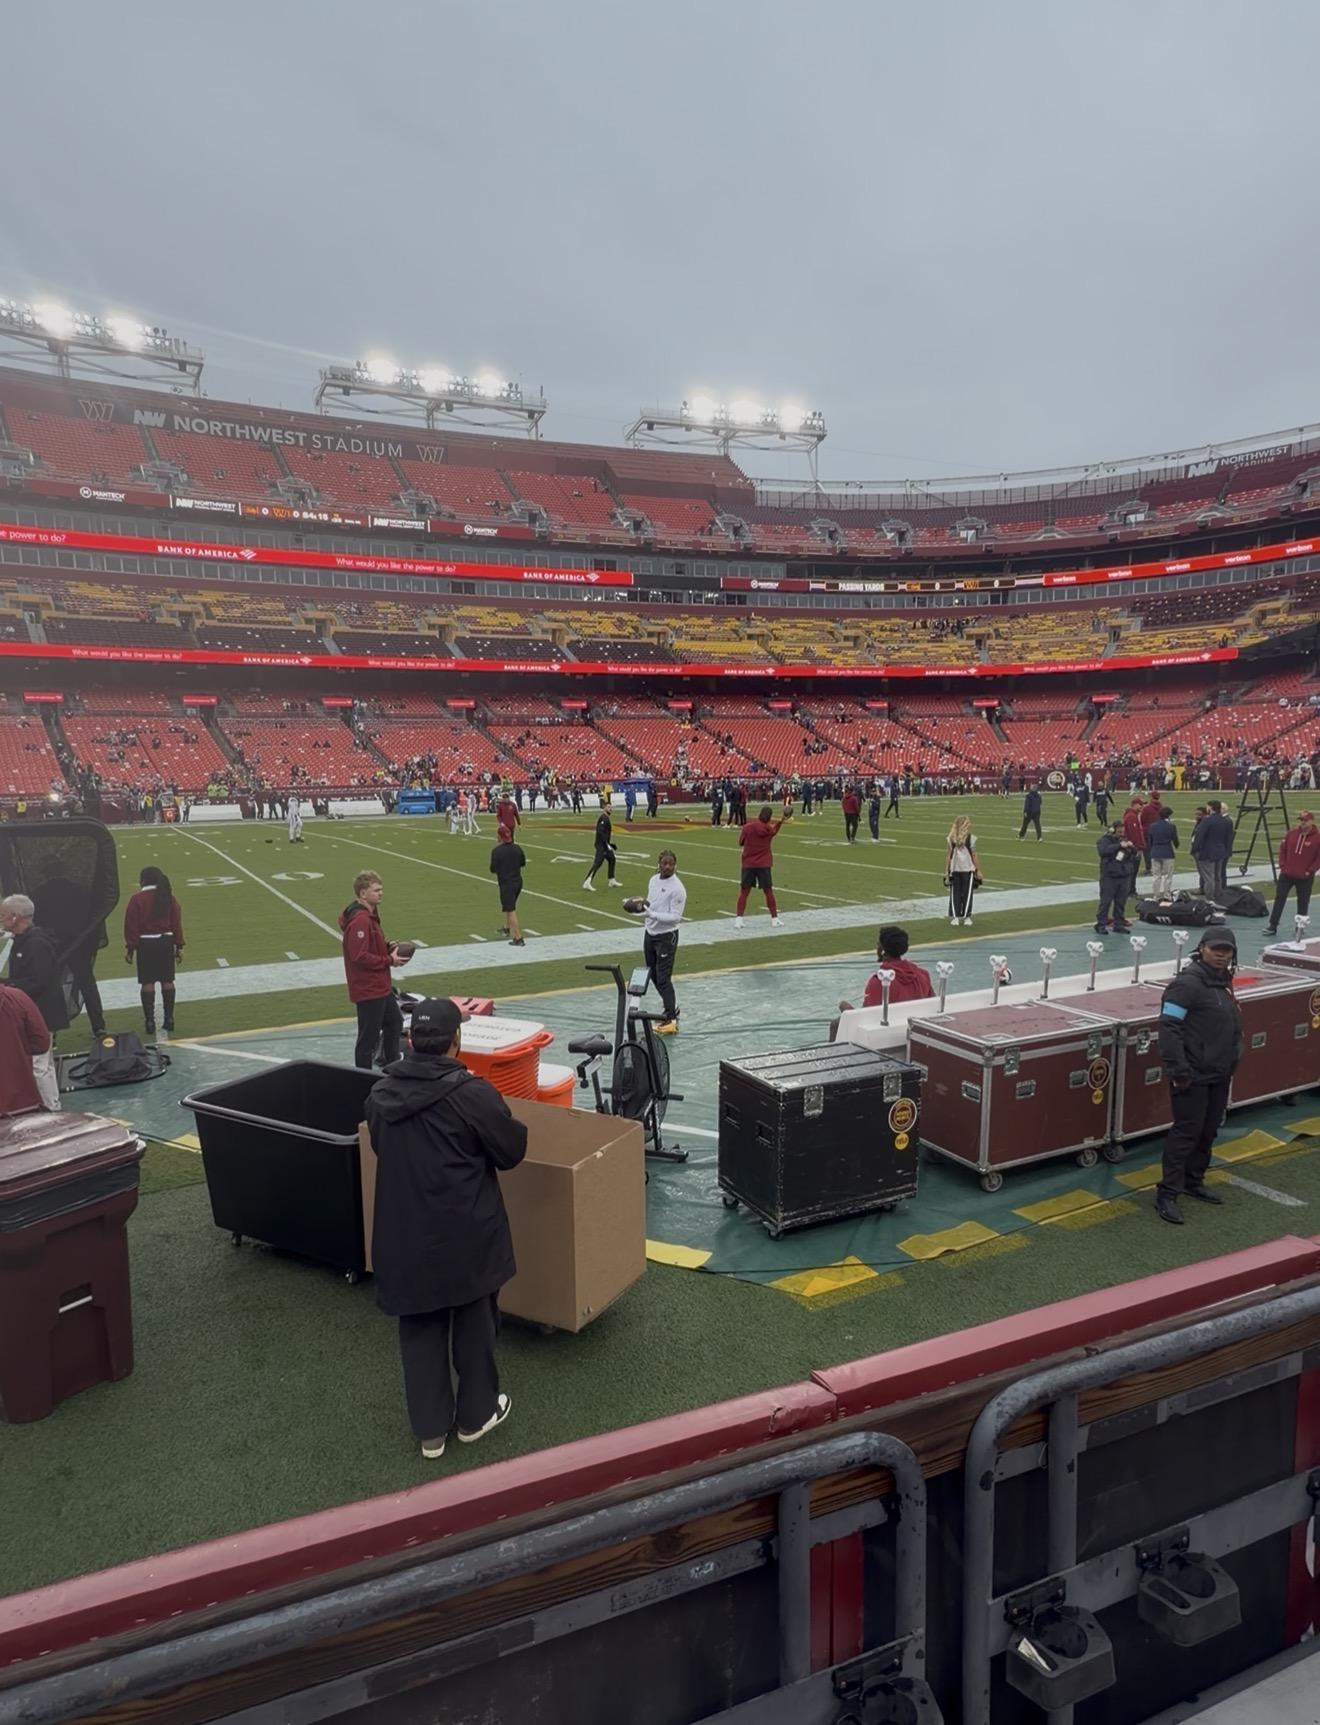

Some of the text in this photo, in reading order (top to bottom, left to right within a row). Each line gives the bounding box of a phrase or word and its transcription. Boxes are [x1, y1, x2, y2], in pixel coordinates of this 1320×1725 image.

[174, 415, 307, 446] NORTHWEST
[311, 434, 403, 458] STADIUM
[1220, 446, 1289, 466] NORTHWEST
[9, 531, 37, 541] power
[50, 535, 66, 543] do?
[157, 545, 239, 559] BANK OF AMERICA
[336, 558, 353, 566] What
[355, 560, 375, 568] would
[523, 572, 543, 580] BANK
[554, 573, 585, 581] AMERICA
